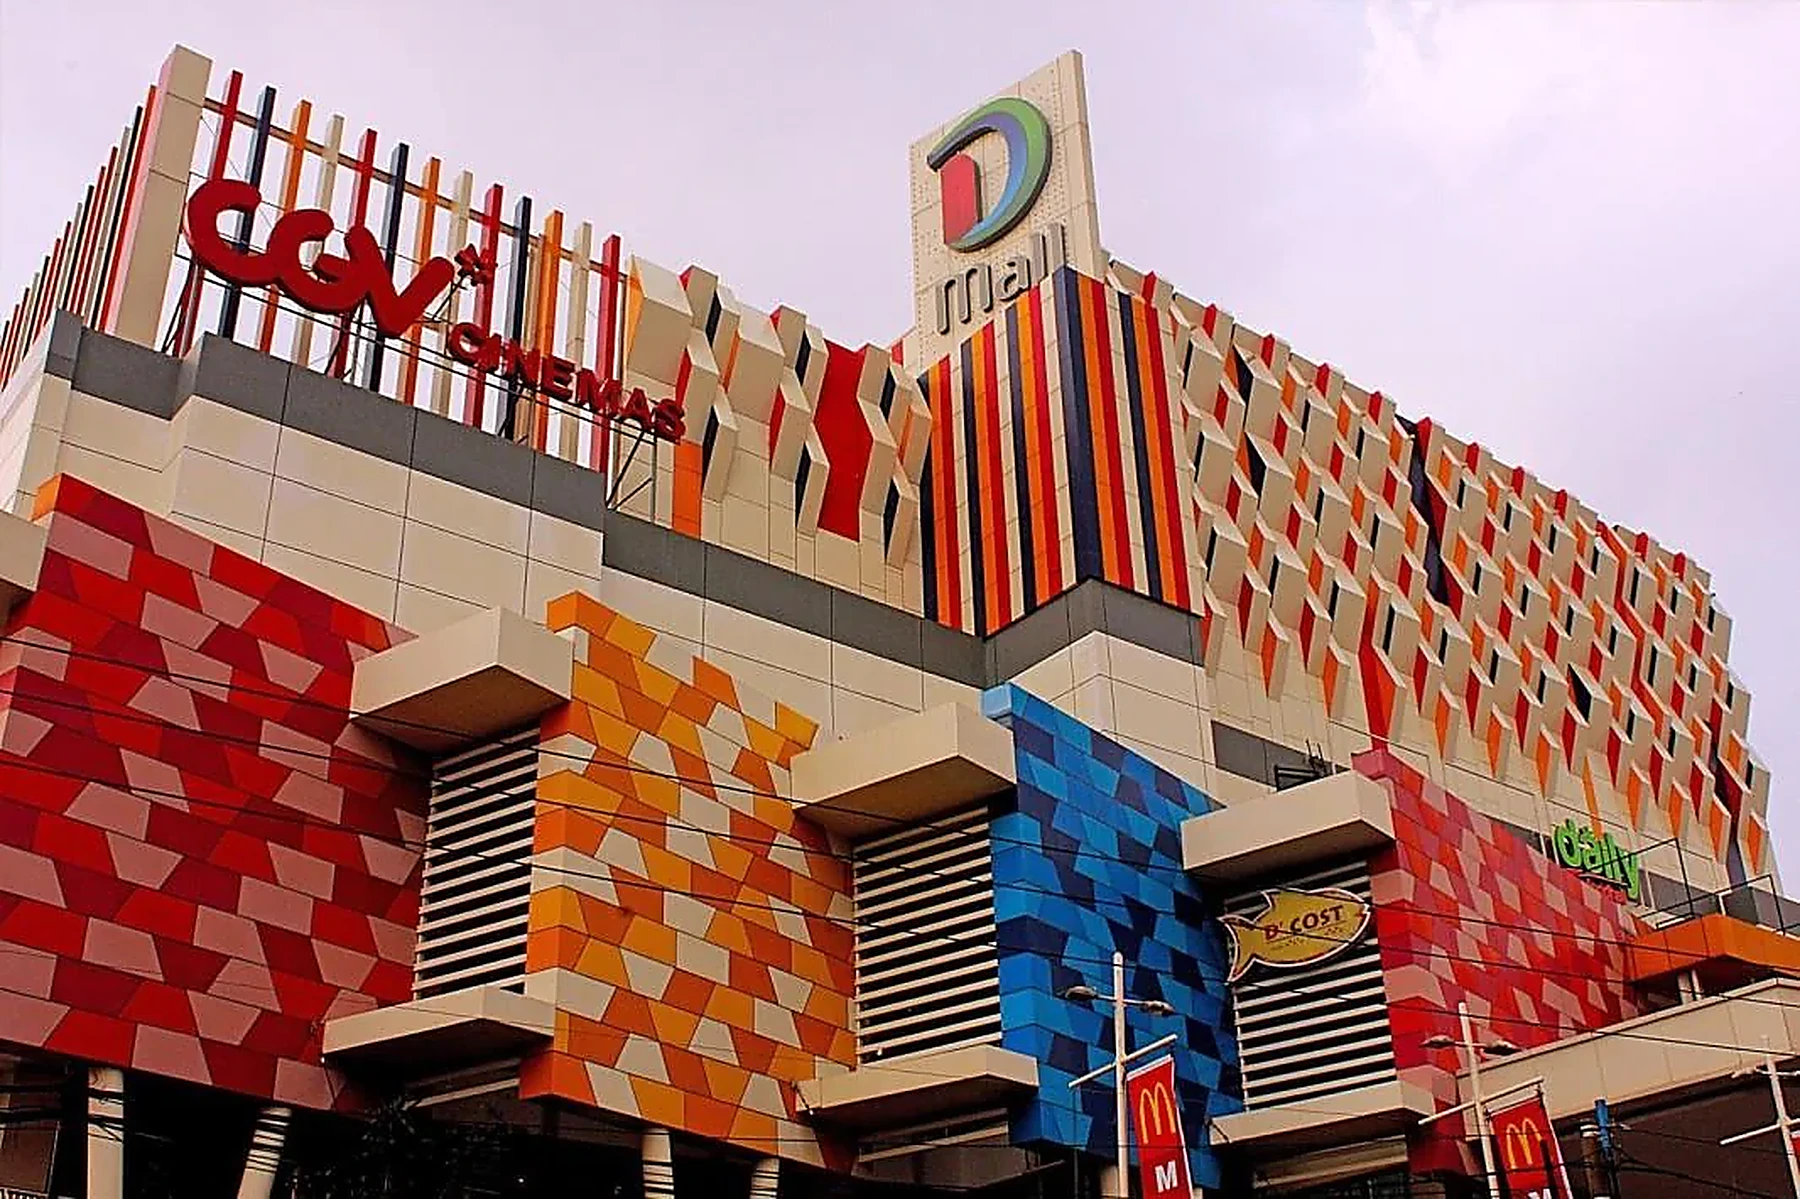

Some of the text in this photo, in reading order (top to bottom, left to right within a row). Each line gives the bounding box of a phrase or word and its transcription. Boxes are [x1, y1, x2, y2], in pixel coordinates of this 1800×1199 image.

[184, 179, 455, 338] CGV
[935, 222, 1066, 336] mall
[447, 321, 687, 445] CINEMAS
[1154, 1160, 1179, 1194] M
